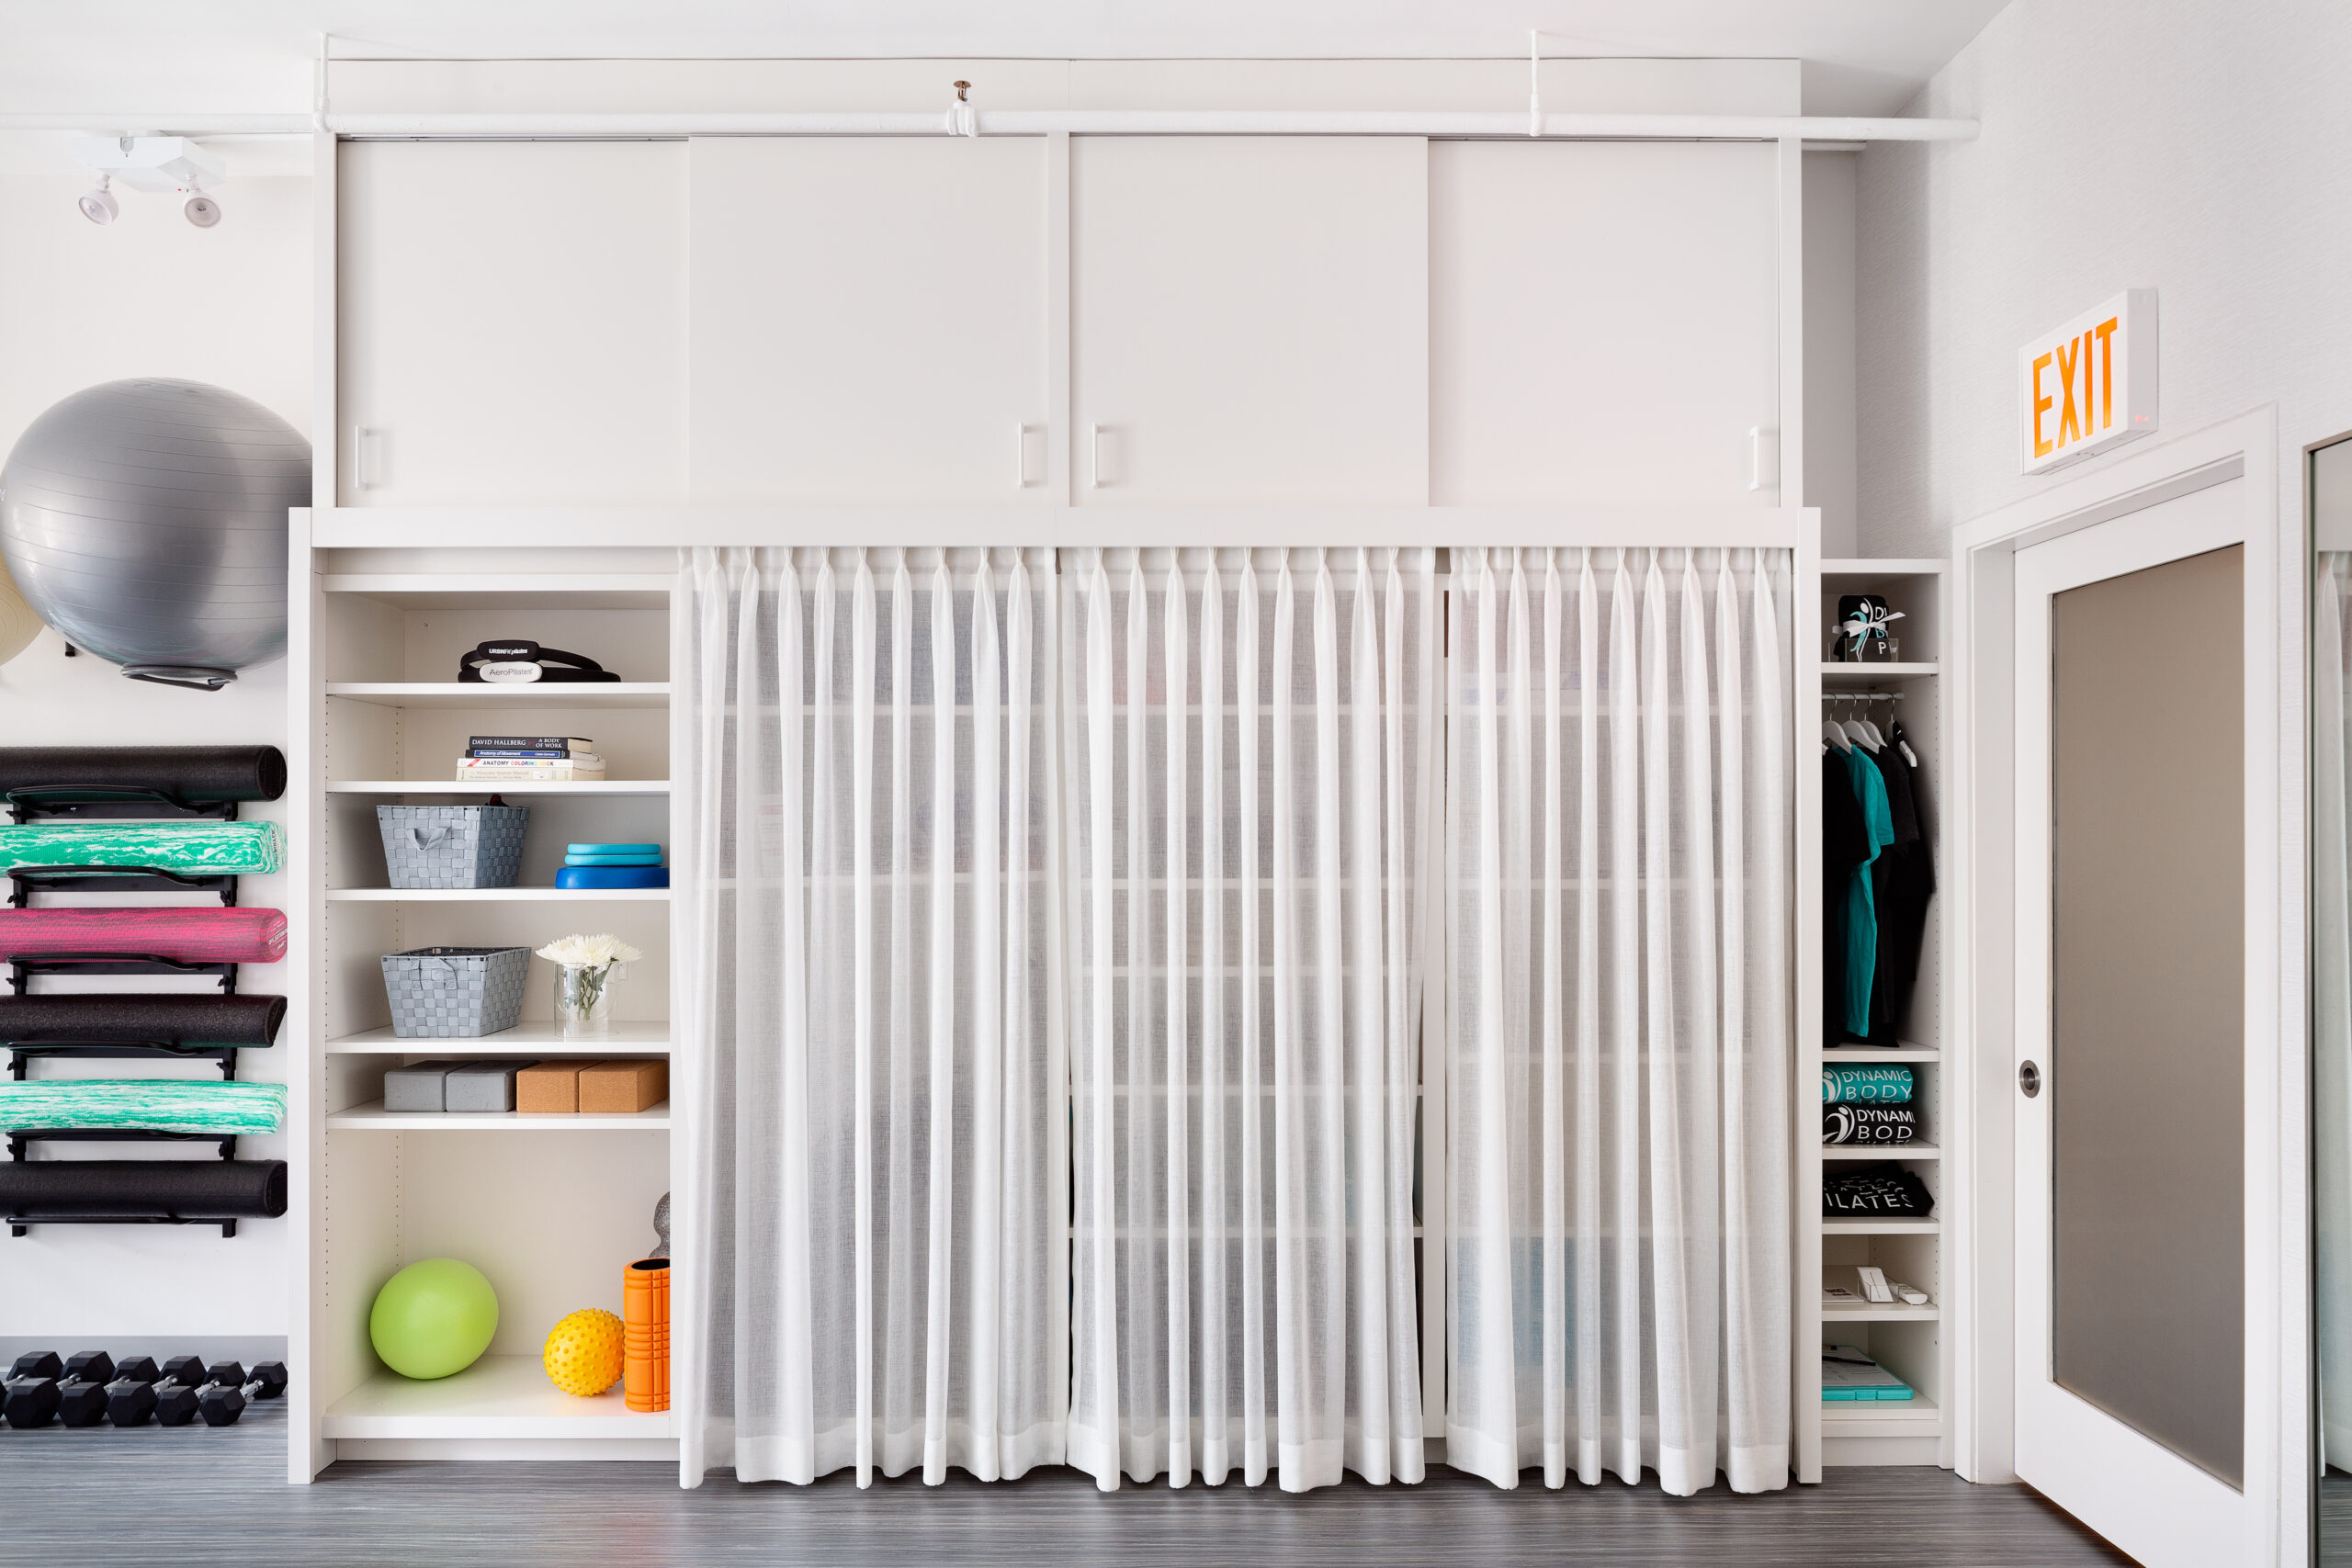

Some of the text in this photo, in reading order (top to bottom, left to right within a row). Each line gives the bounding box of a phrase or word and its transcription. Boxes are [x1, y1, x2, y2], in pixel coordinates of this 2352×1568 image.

[2032, 316, 2118, 459] EXIT
[1841, 1069, 1912, 1083] DYNAMIC
[1845, 1085, 1913, 1100] BODY
[1857, 1125, 1913, 1140] BOD
